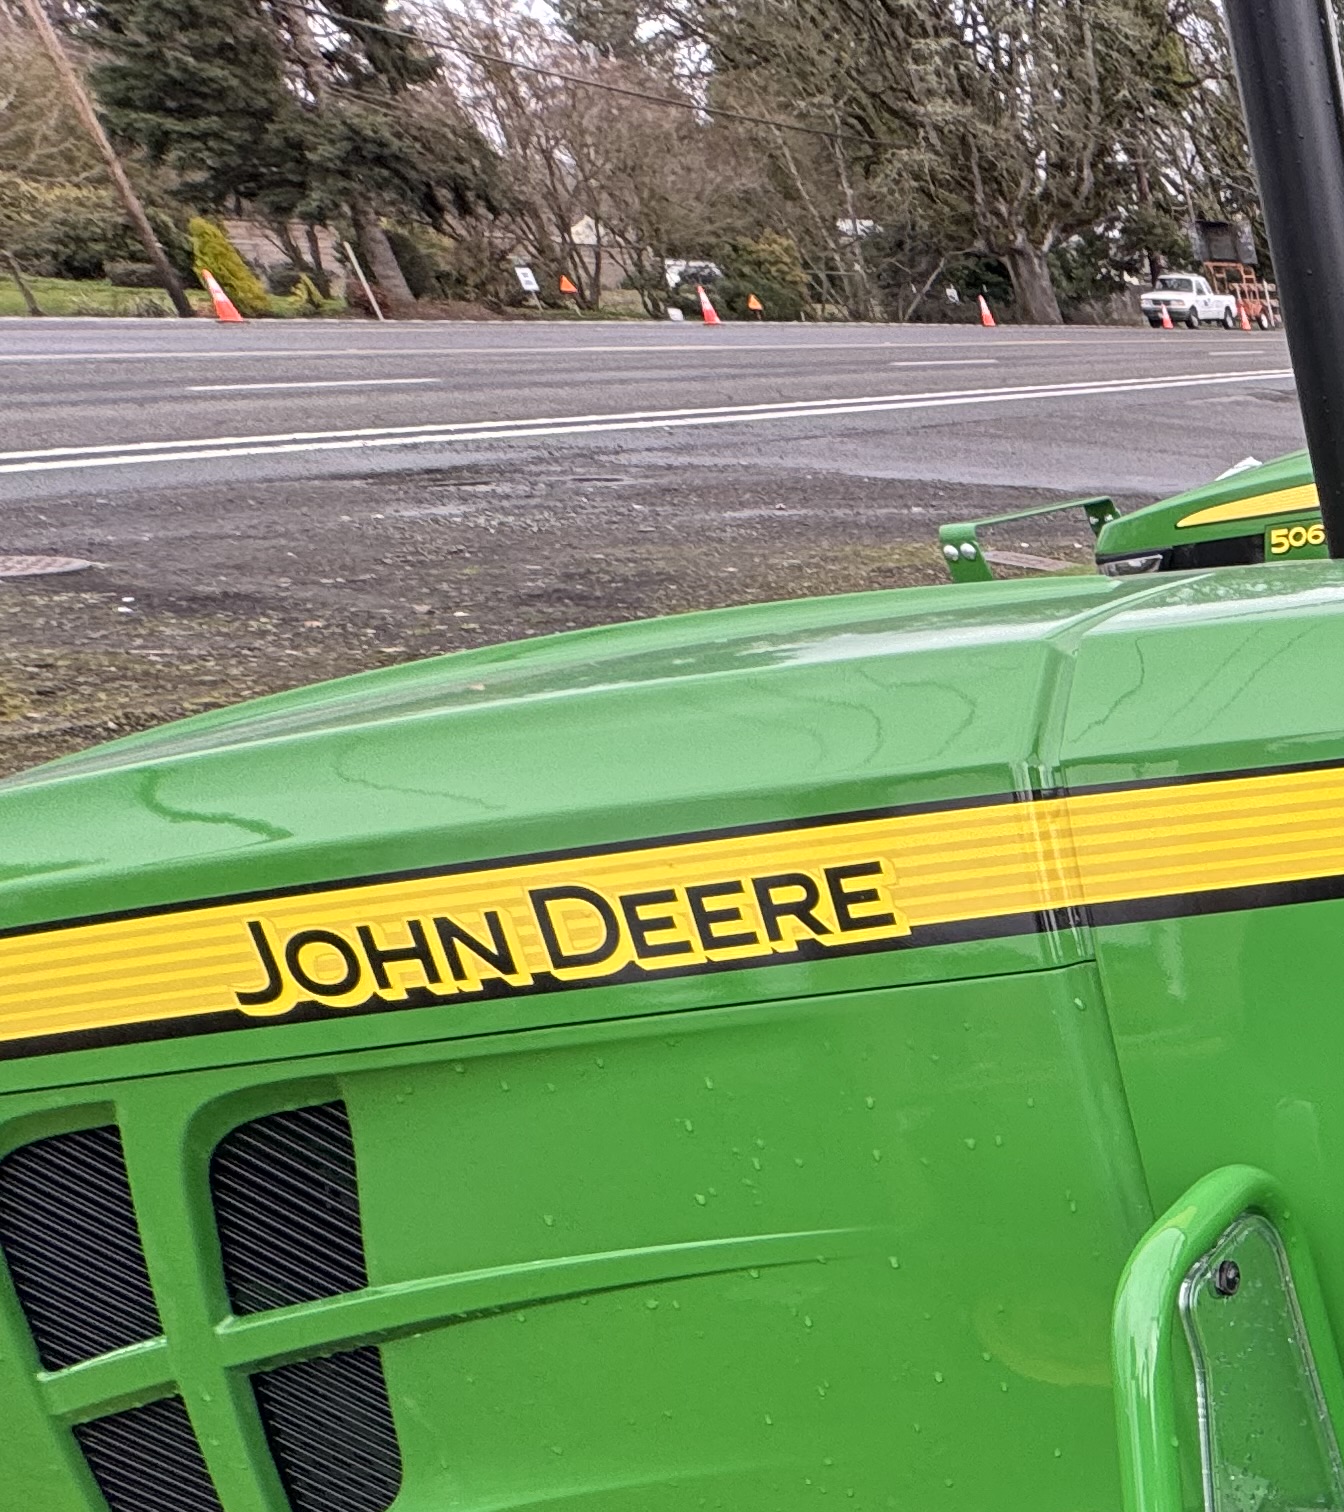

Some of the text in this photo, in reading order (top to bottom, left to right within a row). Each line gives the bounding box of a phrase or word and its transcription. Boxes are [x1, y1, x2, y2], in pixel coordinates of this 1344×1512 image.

[1270, 523, 1327, 554] 506
[235, 860, 898, 1004] JOHN DEERE
